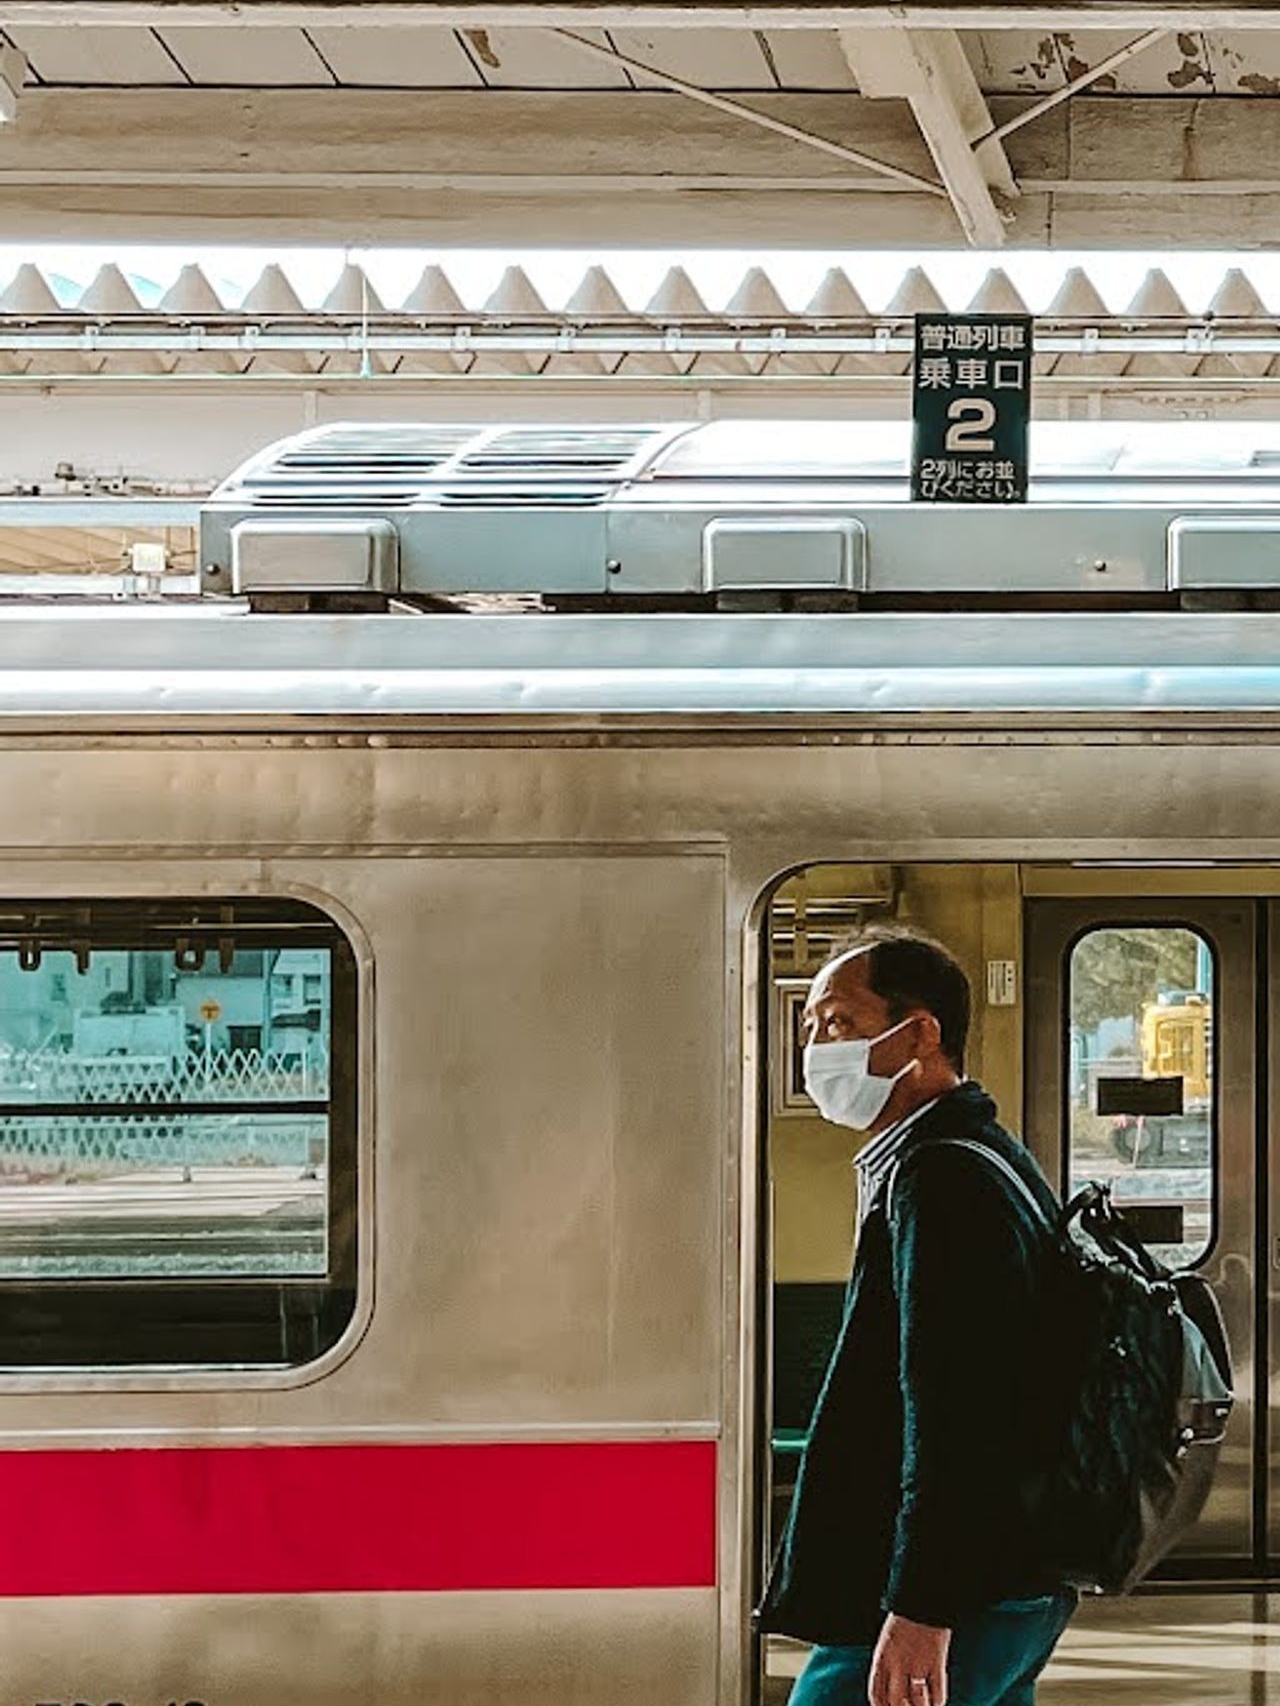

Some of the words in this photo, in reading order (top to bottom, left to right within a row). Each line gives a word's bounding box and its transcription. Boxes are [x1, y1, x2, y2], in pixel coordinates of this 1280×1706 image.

[920, 325, 1026, 351] 普通列車
[918, 358, 1024, 389] 乗車口
[945, 398, 995, 452] 2
[920, 459, 1015, 481] 2列にお並
